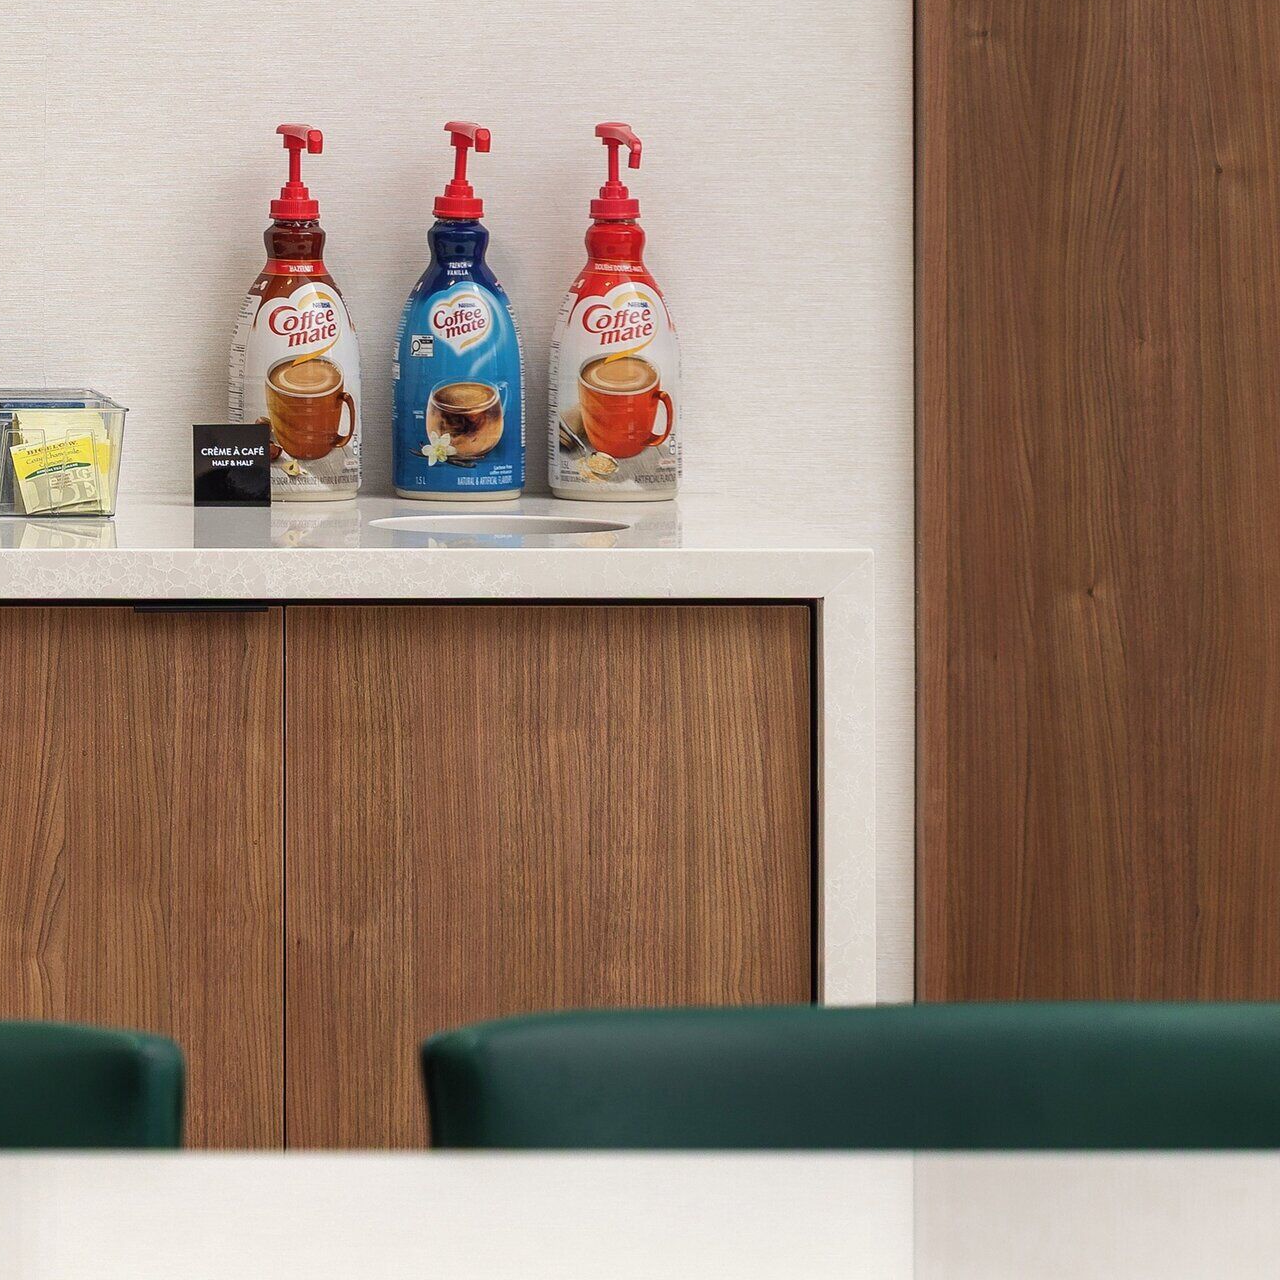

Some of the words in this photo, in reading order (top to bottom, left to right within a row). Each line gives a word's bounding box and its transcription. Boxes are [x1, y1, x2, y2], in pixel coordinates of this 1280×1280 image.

[269, 305, 334, 336] Coffee
[433, 308, 482, 329] Coffee
[446, 318, 486, 339] mate
[582, 304, 651, 334] Coffee
[288, 323, 337, 347] mate
[600, 322, 653, 345] mate
[201, 446, 232, 456] CRÈME
[233, 445, 240, 456] À
[241, 446, 265, 456] CAFÉ
[212, 459, 230, 467] HALF
[230, 459, 236, 467] &
[236, 459, 254, 467] HALF
